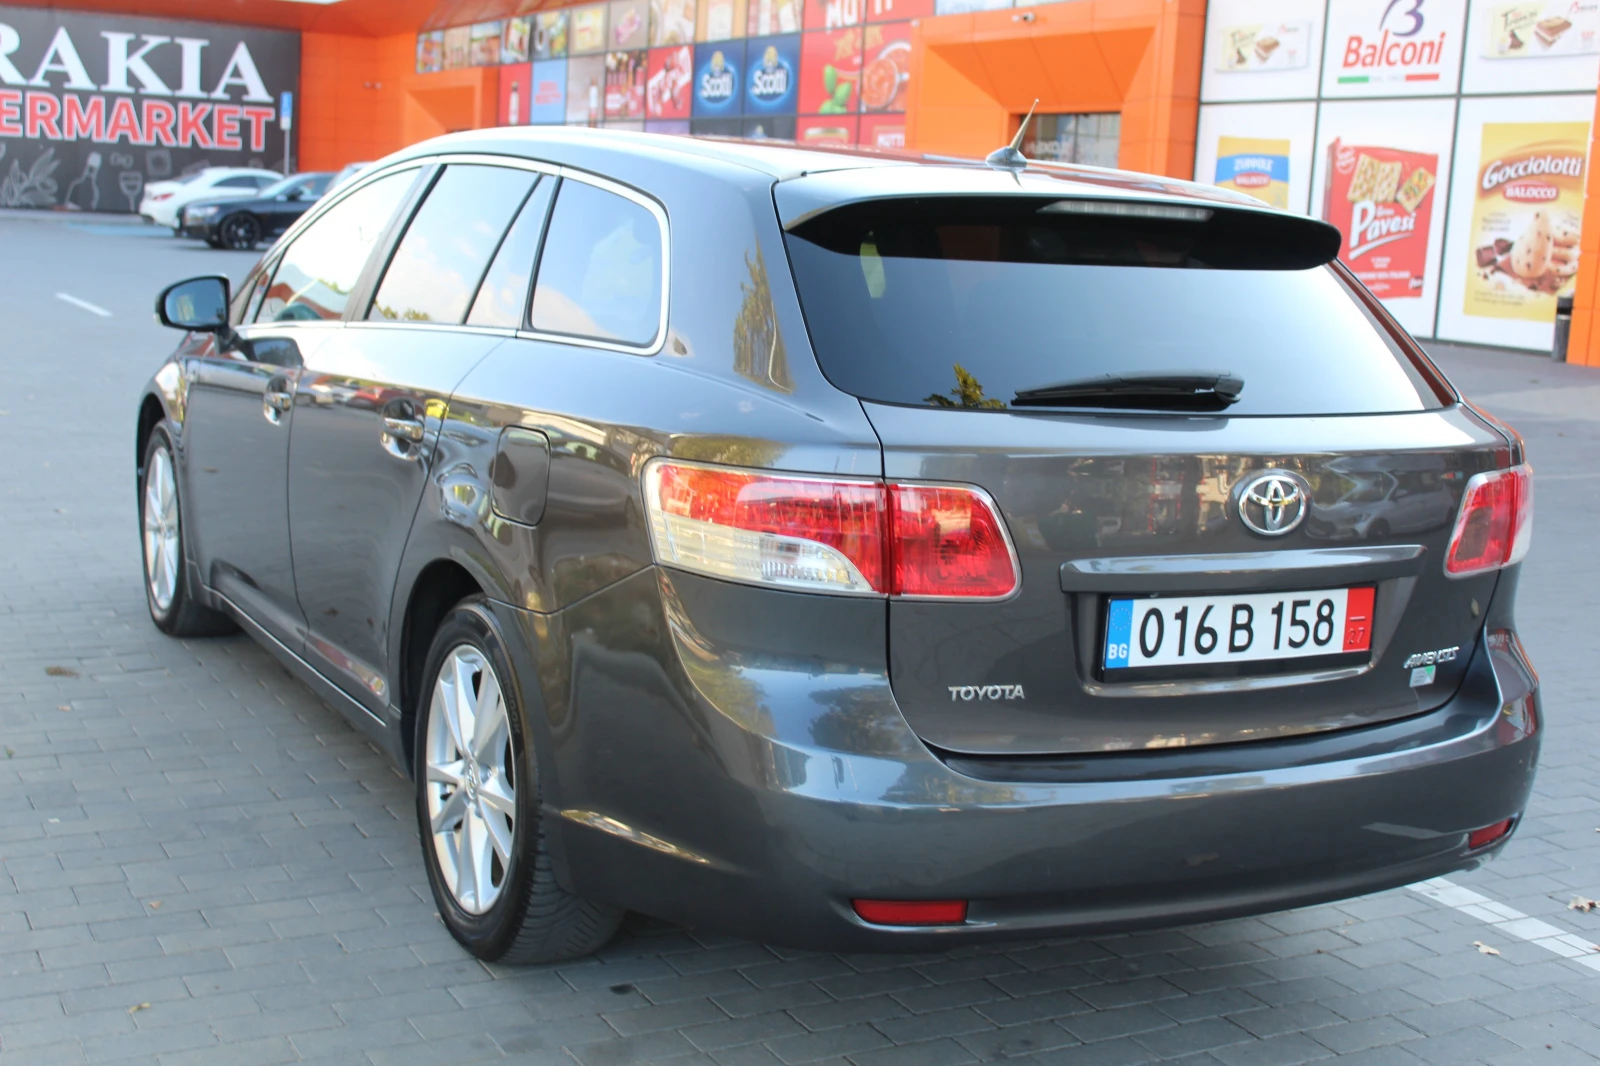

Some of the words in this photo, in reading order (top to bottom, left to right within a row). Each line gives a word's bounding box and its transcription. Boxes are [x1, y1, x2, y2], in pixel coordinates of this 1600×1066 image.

[1342, 29, 1446, 68] Balconi
[1482, 156, 1583, 190] Gocciolotti
[1505, 186, 1557, 199] BALOCCO
[1350, 199, 1417, 249] Pavesi
[1139, 604, 1219, 659] 016
[1228, 603, 1255, 654] B
[1271, 598, 1335, 651] 158
[1108, 643, 1128, 660] BG
[947, 684, 1025, 701] TOYOTA
